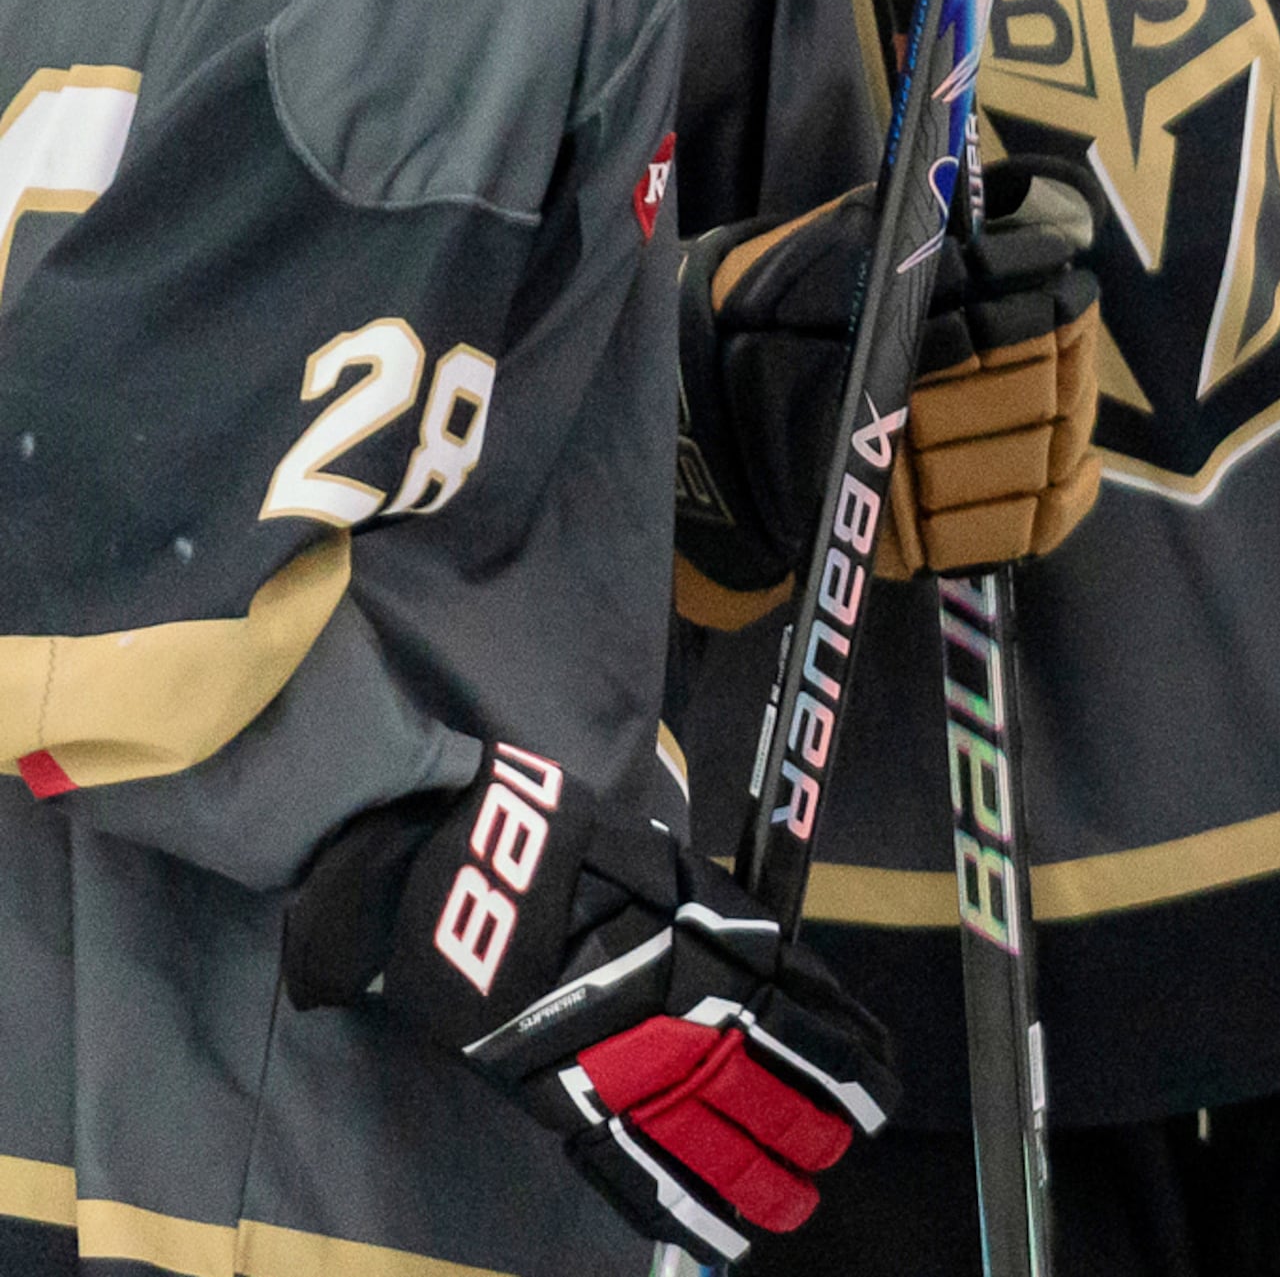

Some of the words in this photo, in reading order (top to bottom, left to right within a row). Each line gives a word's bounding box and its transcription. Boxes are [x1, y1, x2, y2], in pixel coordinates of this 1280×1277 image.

[643, 160, 672, 204] R
[259, 317, 497, 528] 28
[770, 472, 881, 840] BAUER
